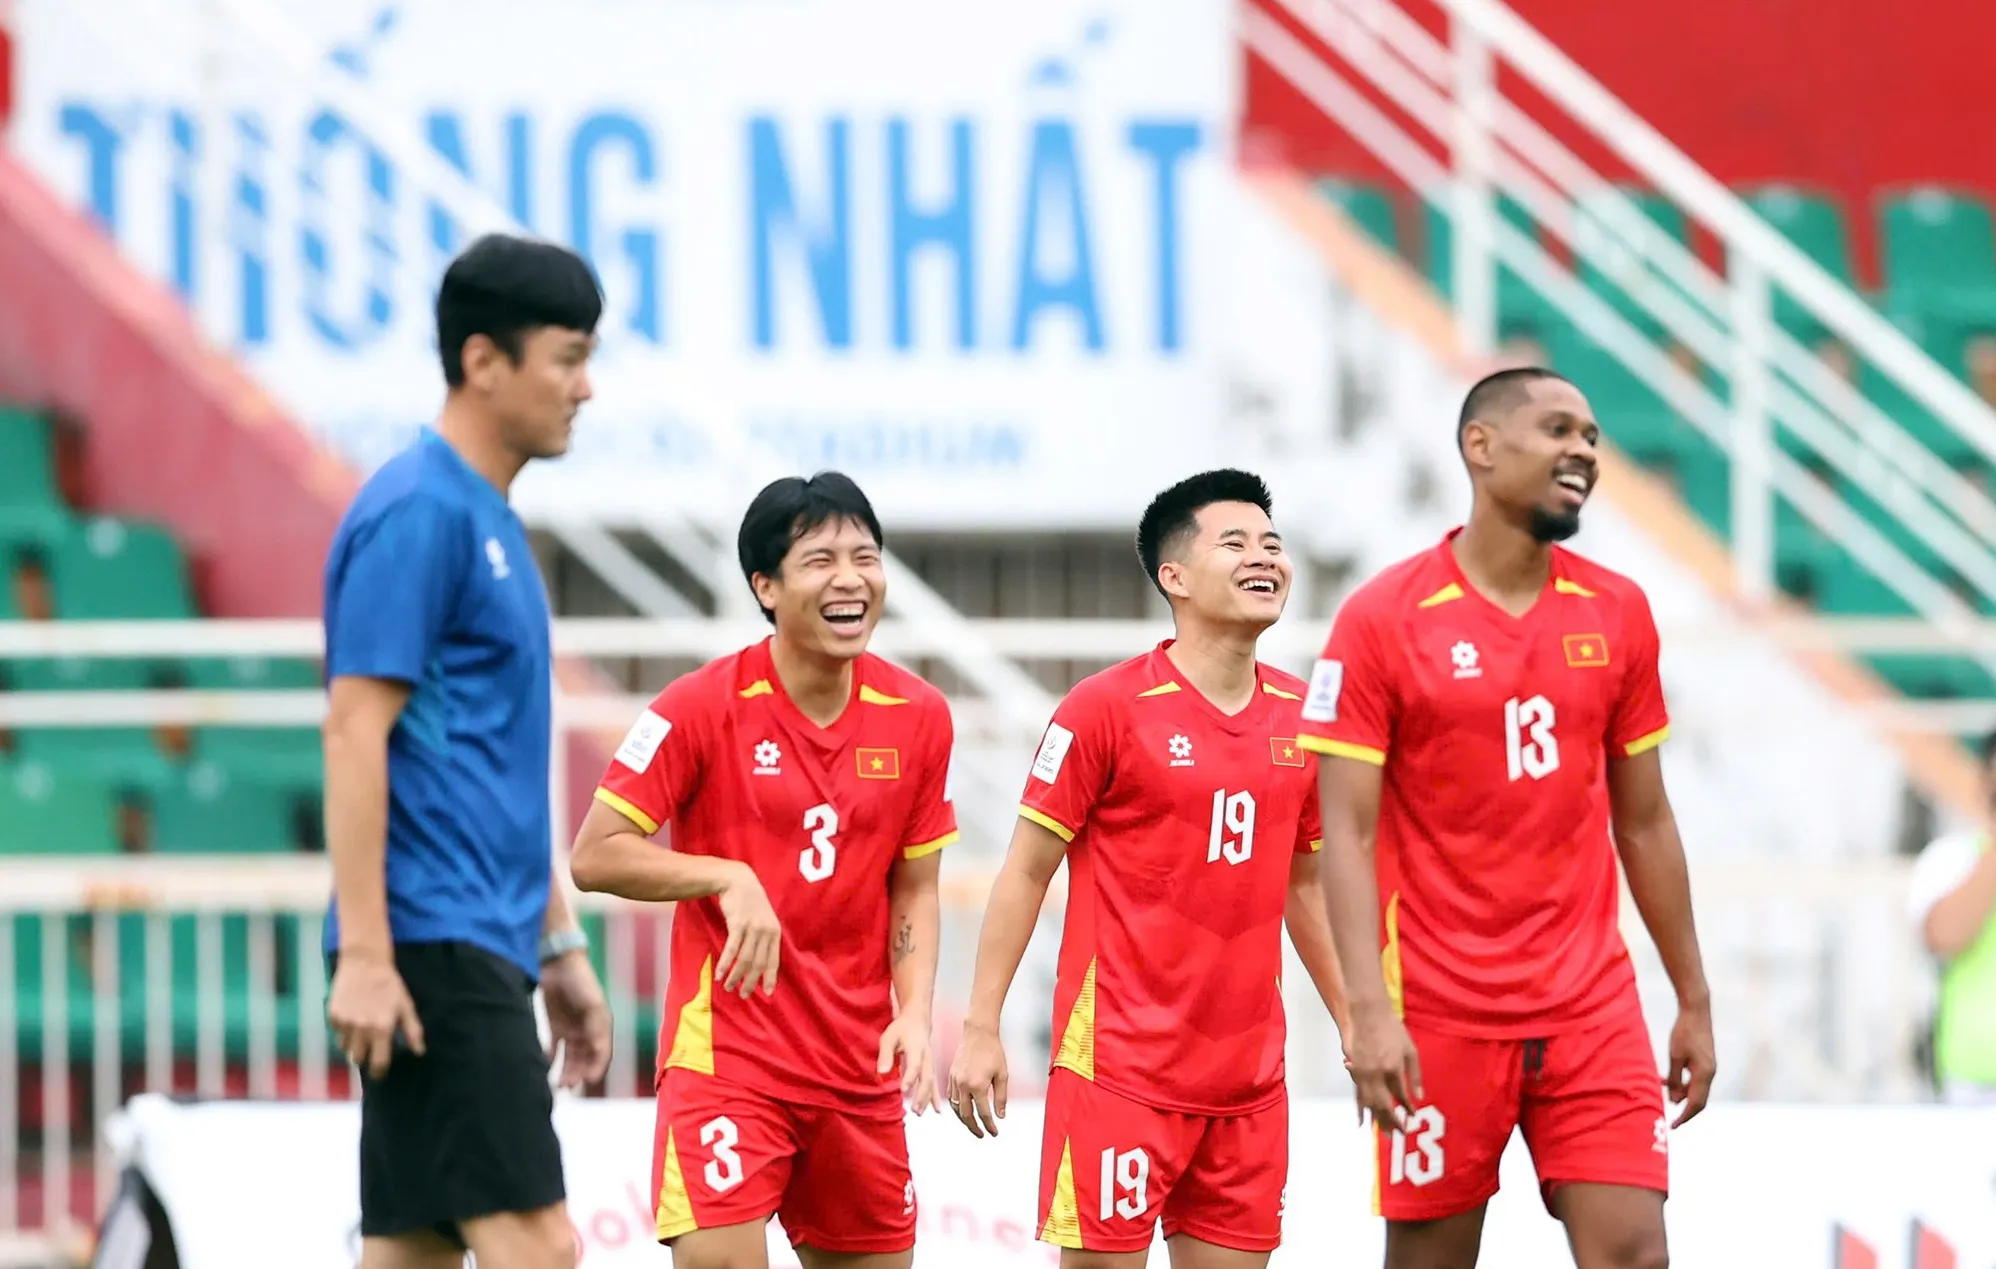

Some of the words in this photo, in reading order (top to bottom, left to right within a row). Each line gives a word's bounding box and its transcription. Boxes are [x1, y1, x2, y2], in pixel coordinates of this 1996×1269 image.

[745, 14, 1204, 353] NHẤT
[1504, 694, 1560, 782] 13
[799, 803, 839, 883] 3
[1207, 788, 1257, 866] 19
[701, 1115, 744, 1193] 3
[1099, 1146, 1150, 1222] 19
[1389, 1104, 1446, 1187] 13
